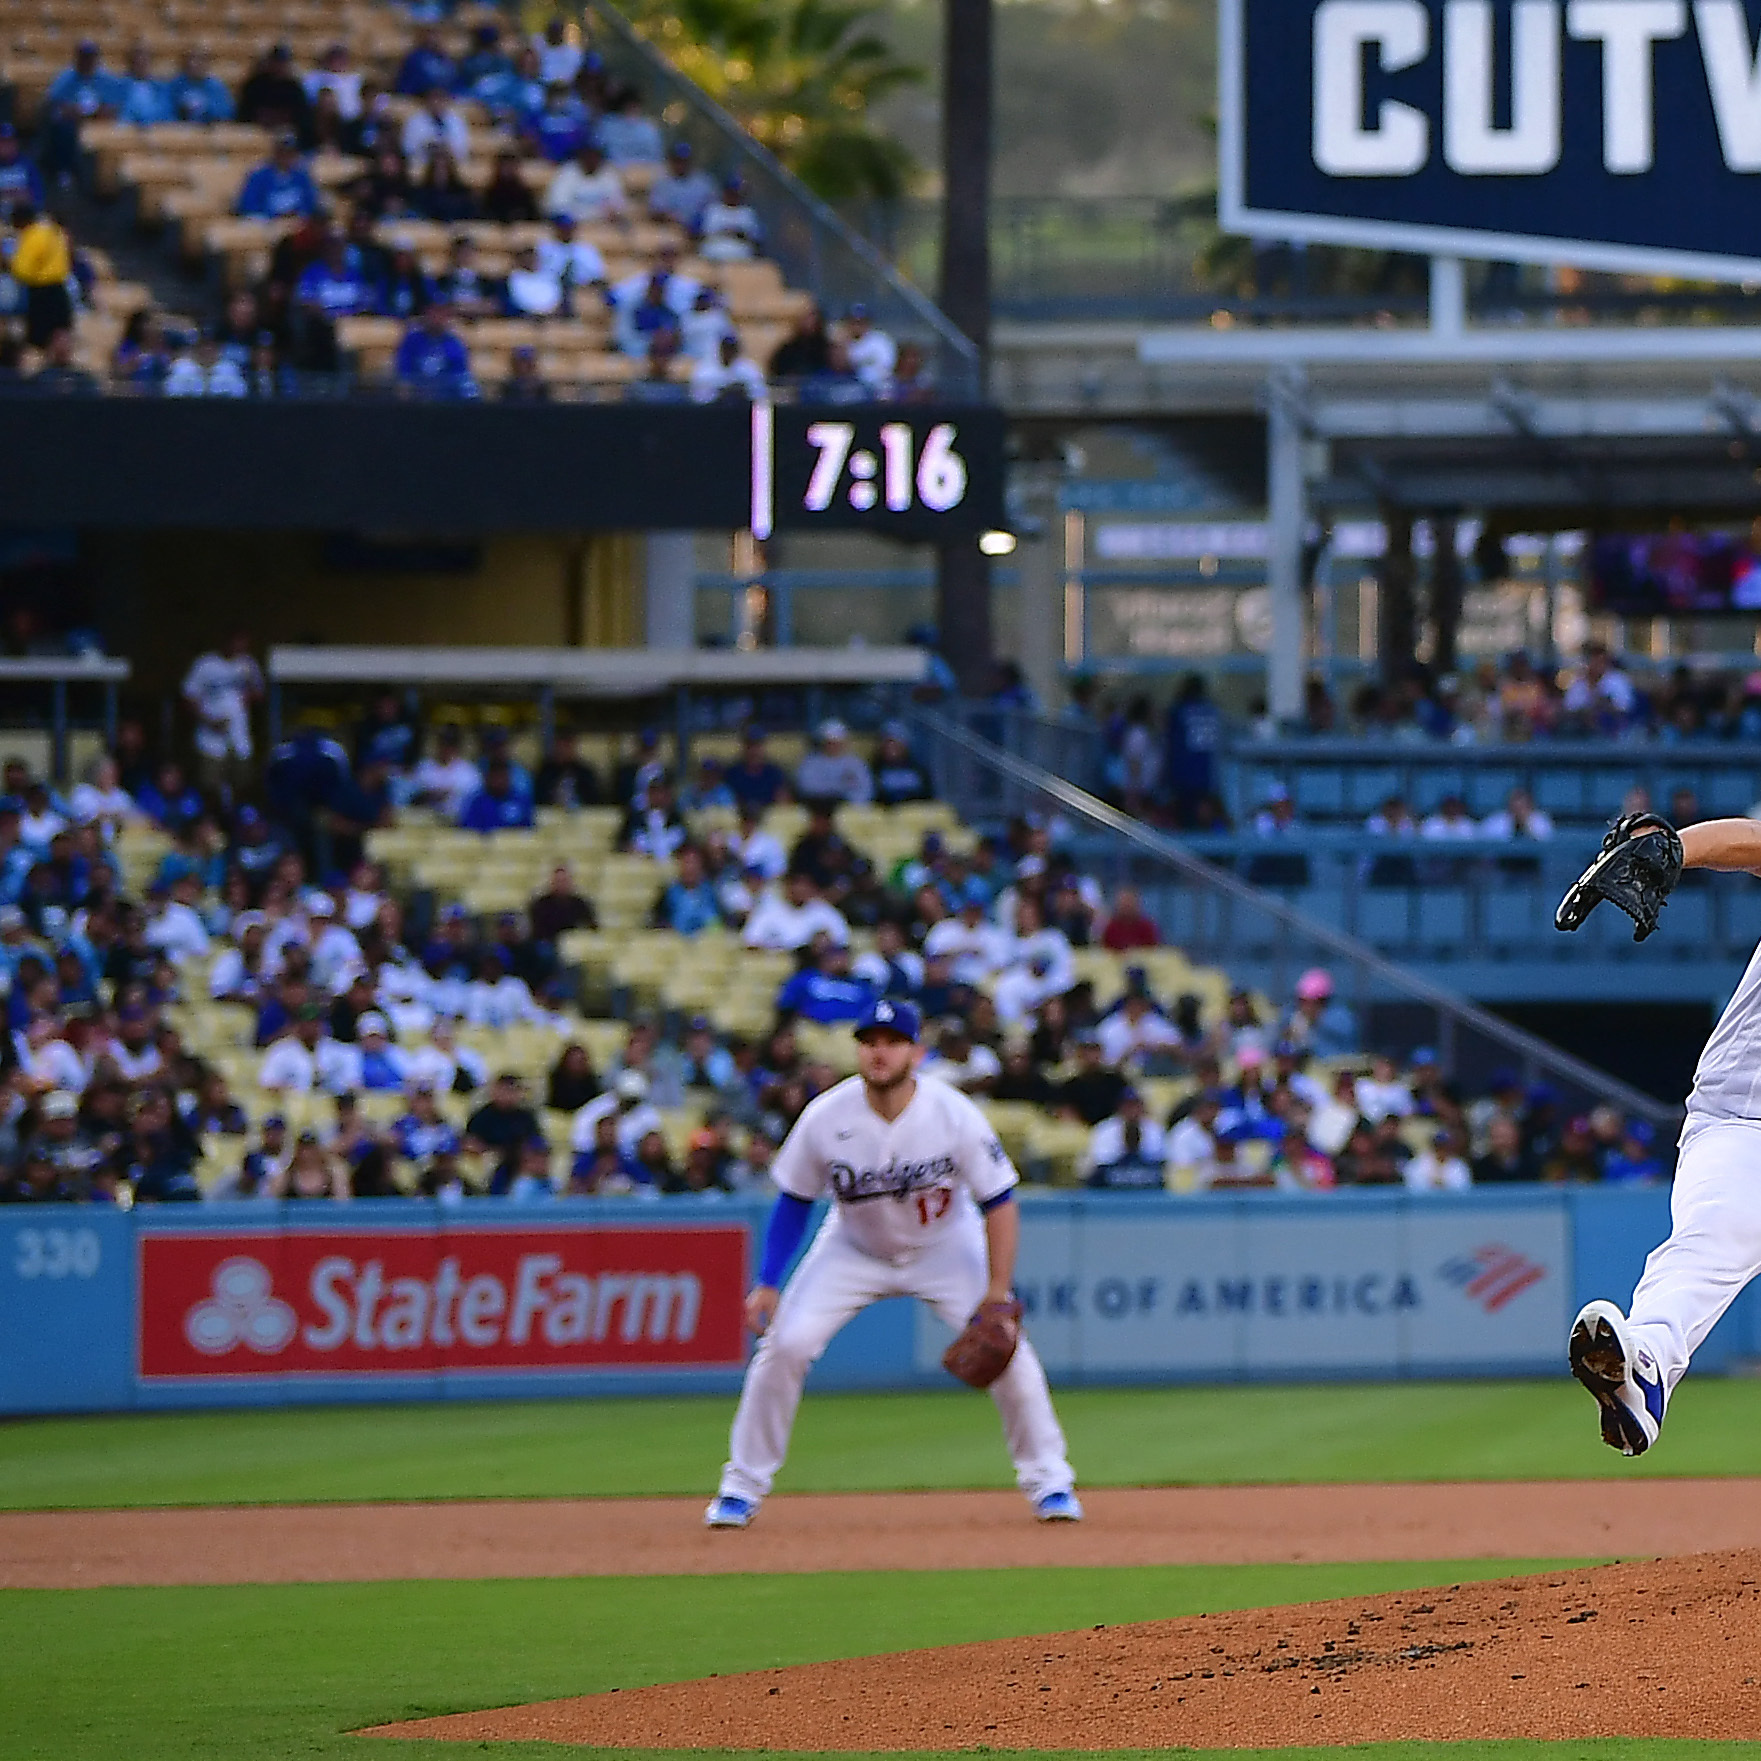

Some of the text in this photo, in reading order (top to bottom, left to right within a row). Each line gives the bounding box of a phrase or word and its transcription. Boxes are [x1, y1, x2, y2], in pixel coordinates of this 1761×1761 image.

[803, 421, 969, 512] 7:16
[917, 1187, 953, 1226] 17
[17, 1227, 102, 1280] 330
[1013, 1274, 1424, 1319] NK OF AMERICA
